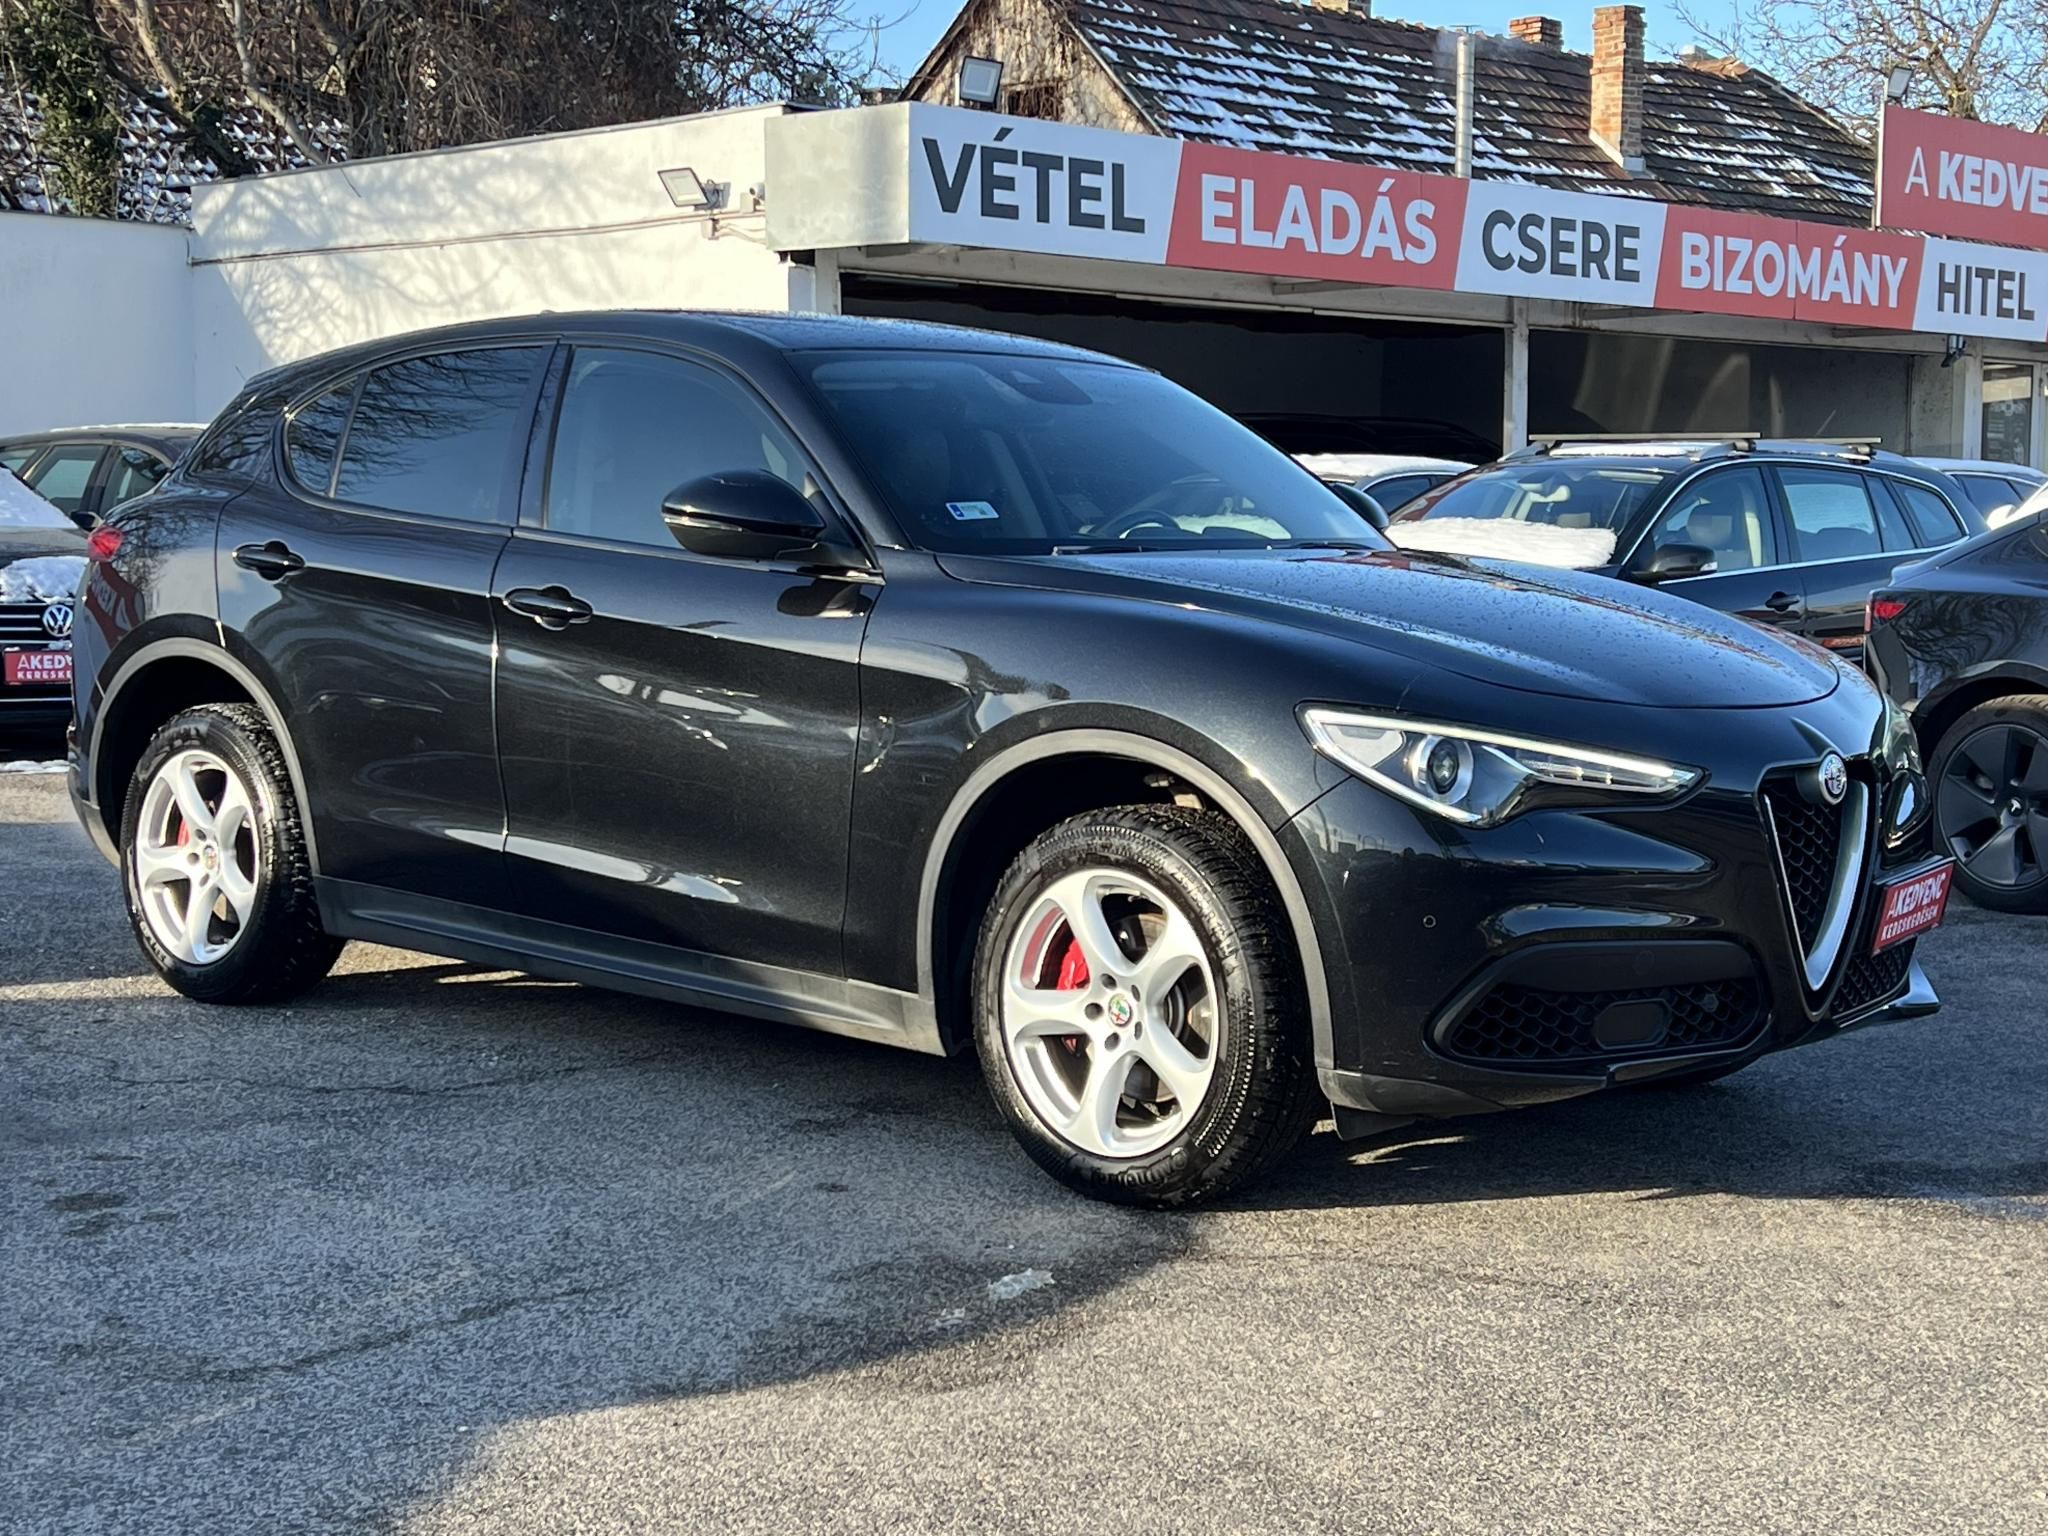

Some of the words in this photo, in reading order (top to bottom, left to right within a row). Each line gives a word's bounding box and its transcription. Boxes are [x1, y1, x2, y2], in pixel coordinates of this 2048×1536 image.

[922, 128, 1146, 234] VÉTEL
[1201, 172, 1437, 265] ELADÁS
[1482, 209, 1641, 283] CSERE
[1680, 231, 1909, 309] BIZOMÁNY
[1937, 262, 2036, 321] HITEL
[1904, 146, 1929, 197] A
[1938, 150, 2048, 216] KEDVE
